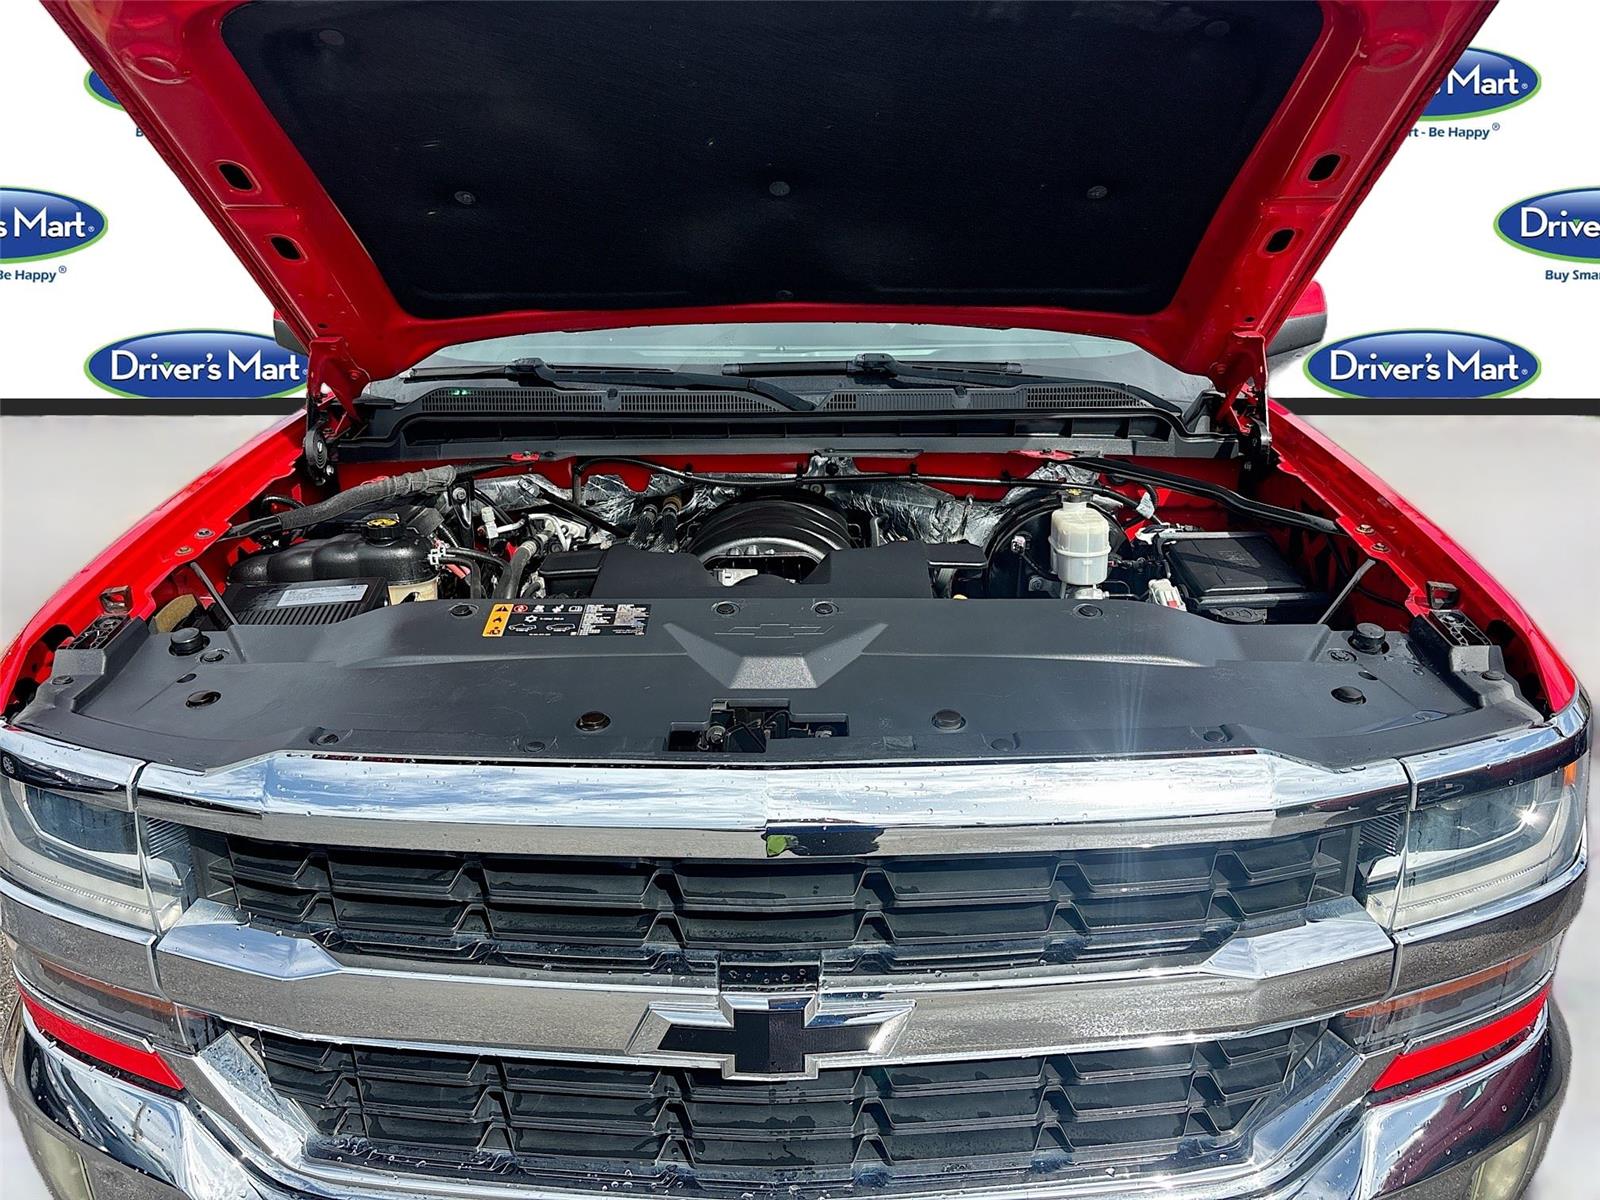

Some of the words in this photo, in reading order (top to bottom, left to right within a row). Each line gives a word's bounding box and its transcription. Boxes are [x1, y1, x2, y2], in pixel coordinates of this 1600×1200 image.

[1447, 64, 1519, 95] Mart
[1428, 127, 1445, 138] Be
[1448, 127, 1490, 141] Happy
[14, 206, 86, 238] Mart
[15, 269, 57, 283] Happy
[1545, 269, 1570, 283] Buy
[1572, 269, 1600, 281] Sma
[111, 349, 222, 381] Driver's
[228, 349, 300, 381] Mart
[1330, 349, 1441, 381] Driver's
[1447, 349, 1519, 381] Mart
